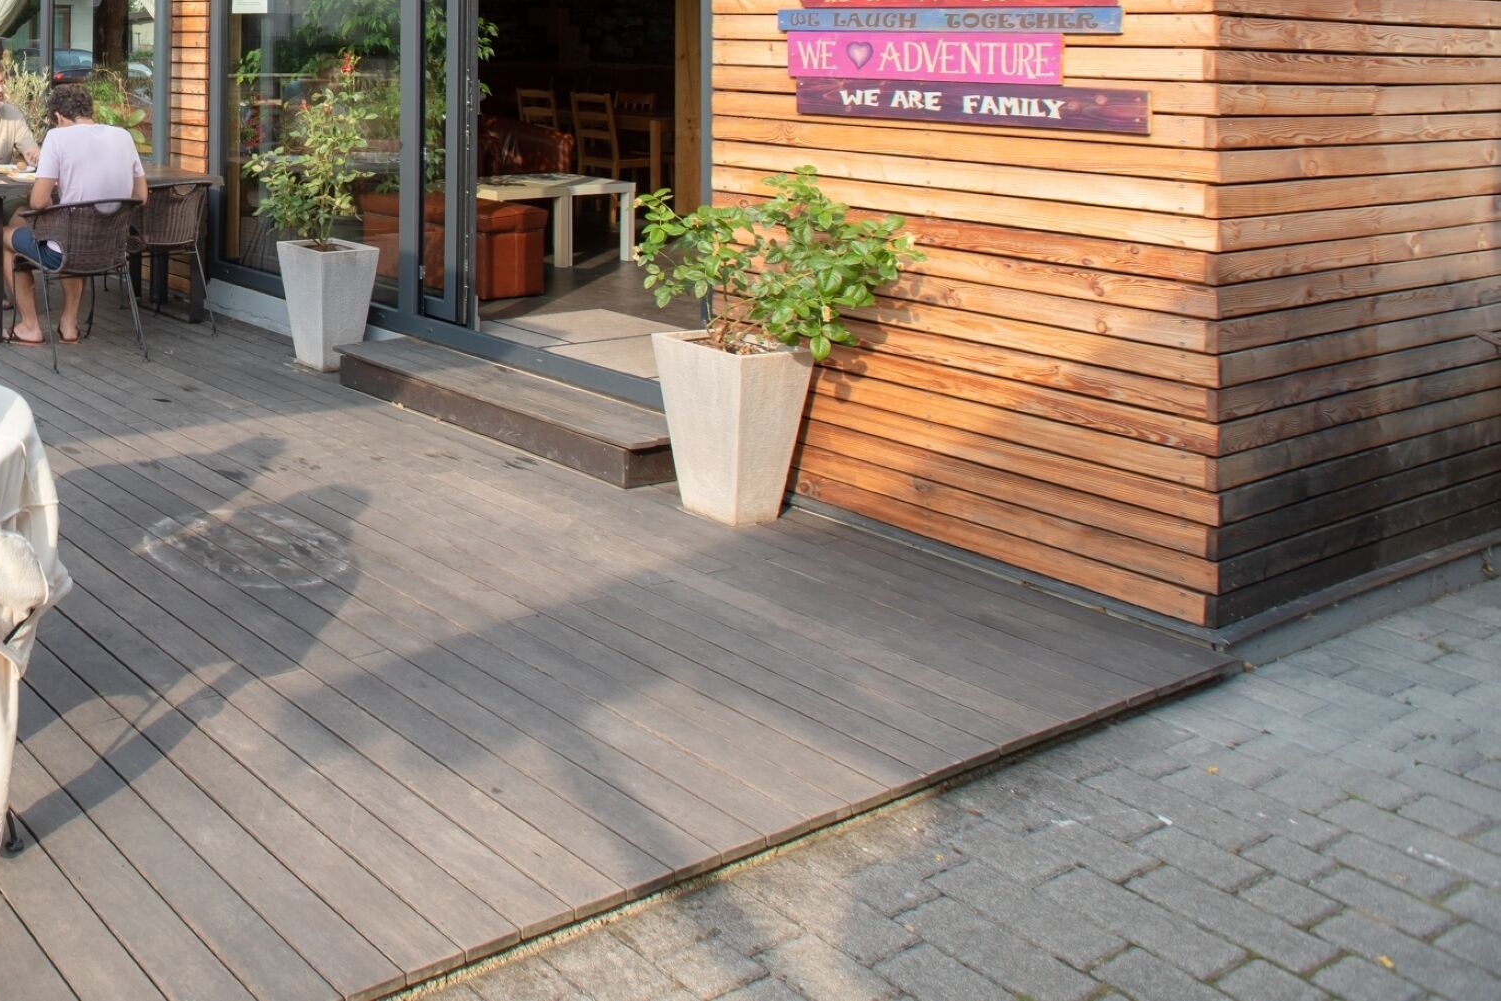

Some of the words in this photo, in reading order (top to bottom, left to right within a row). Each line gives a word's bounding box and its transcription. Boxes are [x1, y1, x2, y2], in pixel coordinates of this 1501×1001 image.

[789, 12, 820, 27] WE
[833, 11, 917, 29] LAUGH
[944, 11, 1099, 30] TOGETHER
[797, 40, 838, 70] WE
[877, 39, 1055, 79] ADVENTURE
[839, 89, 881, 107] WE
[890, 90, 942, 111] ARE
[962, 94, 1066, 120] FAMILY
